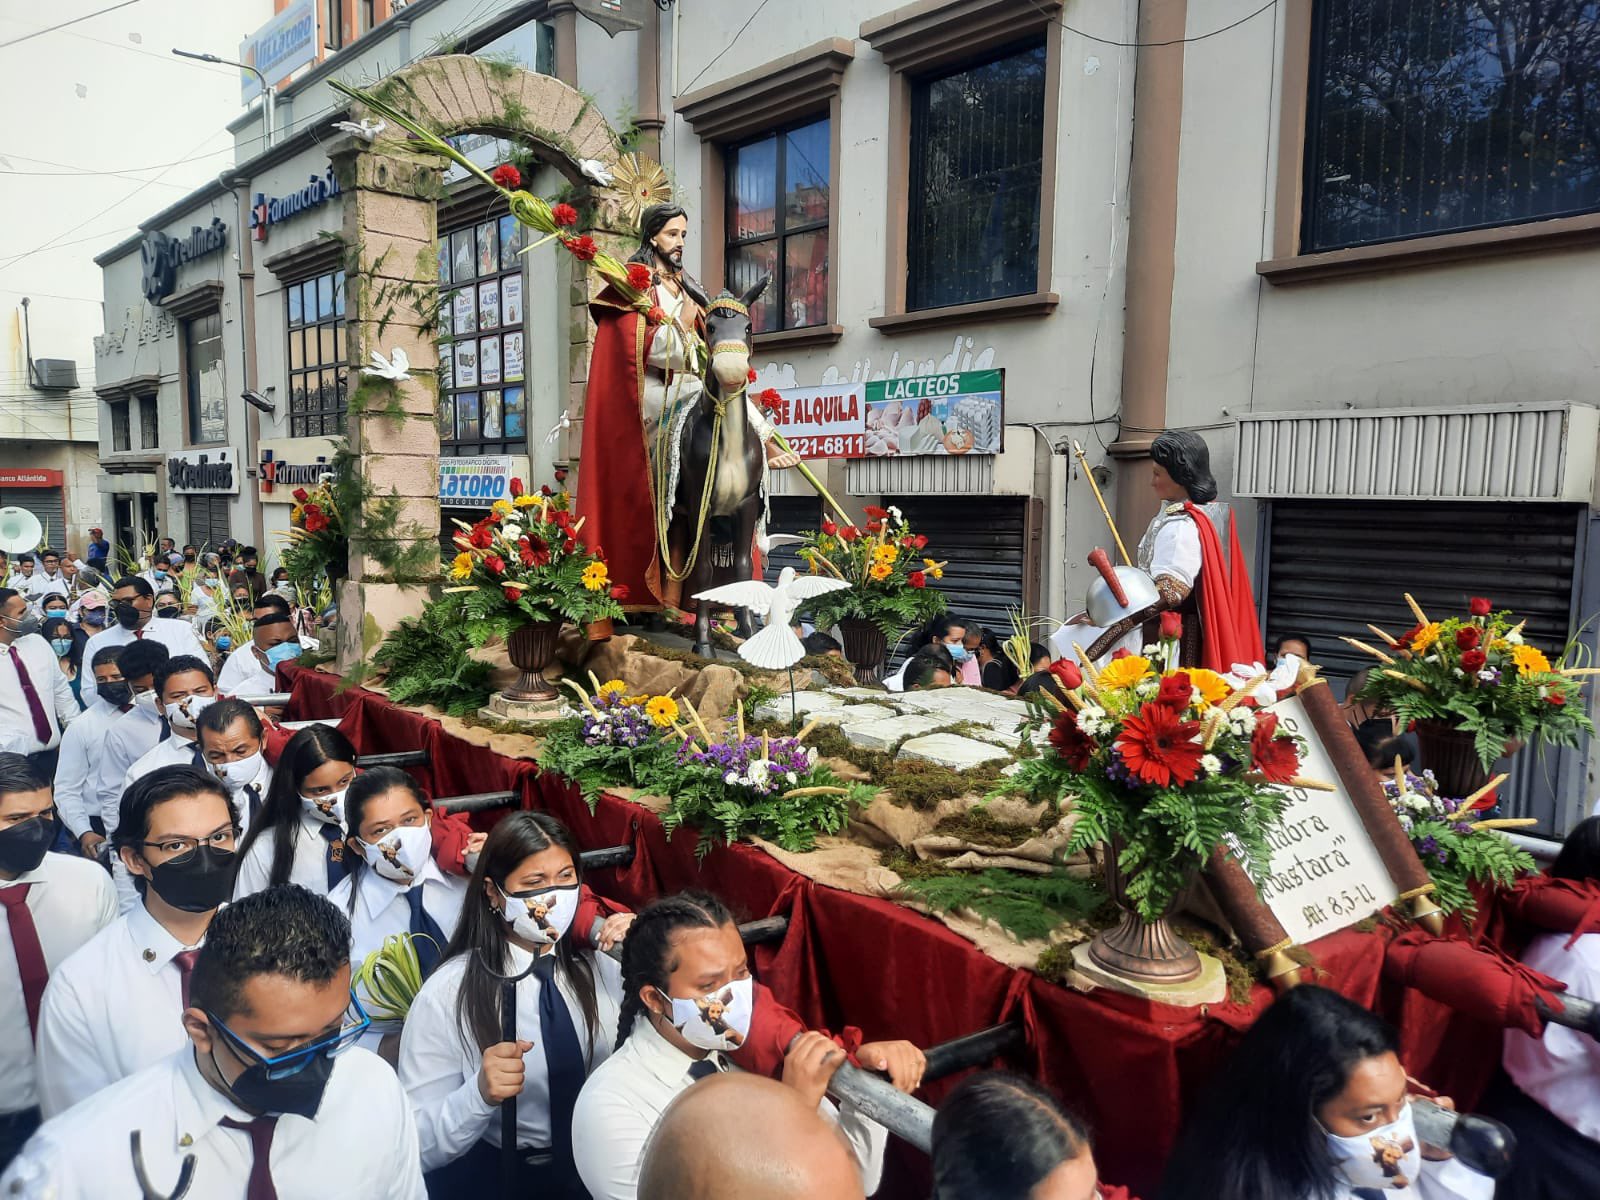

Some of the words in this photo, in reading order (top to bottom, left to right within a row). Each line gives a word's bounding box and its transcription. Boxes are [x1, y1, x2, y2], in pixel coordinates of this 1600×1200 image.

[266, 174, 320, 225] Farmacia
[884, 375, 961, 400] LACTEOS
[774, 399, 790, 425] SE
[794, 394, 859, 426] ALQUILA
